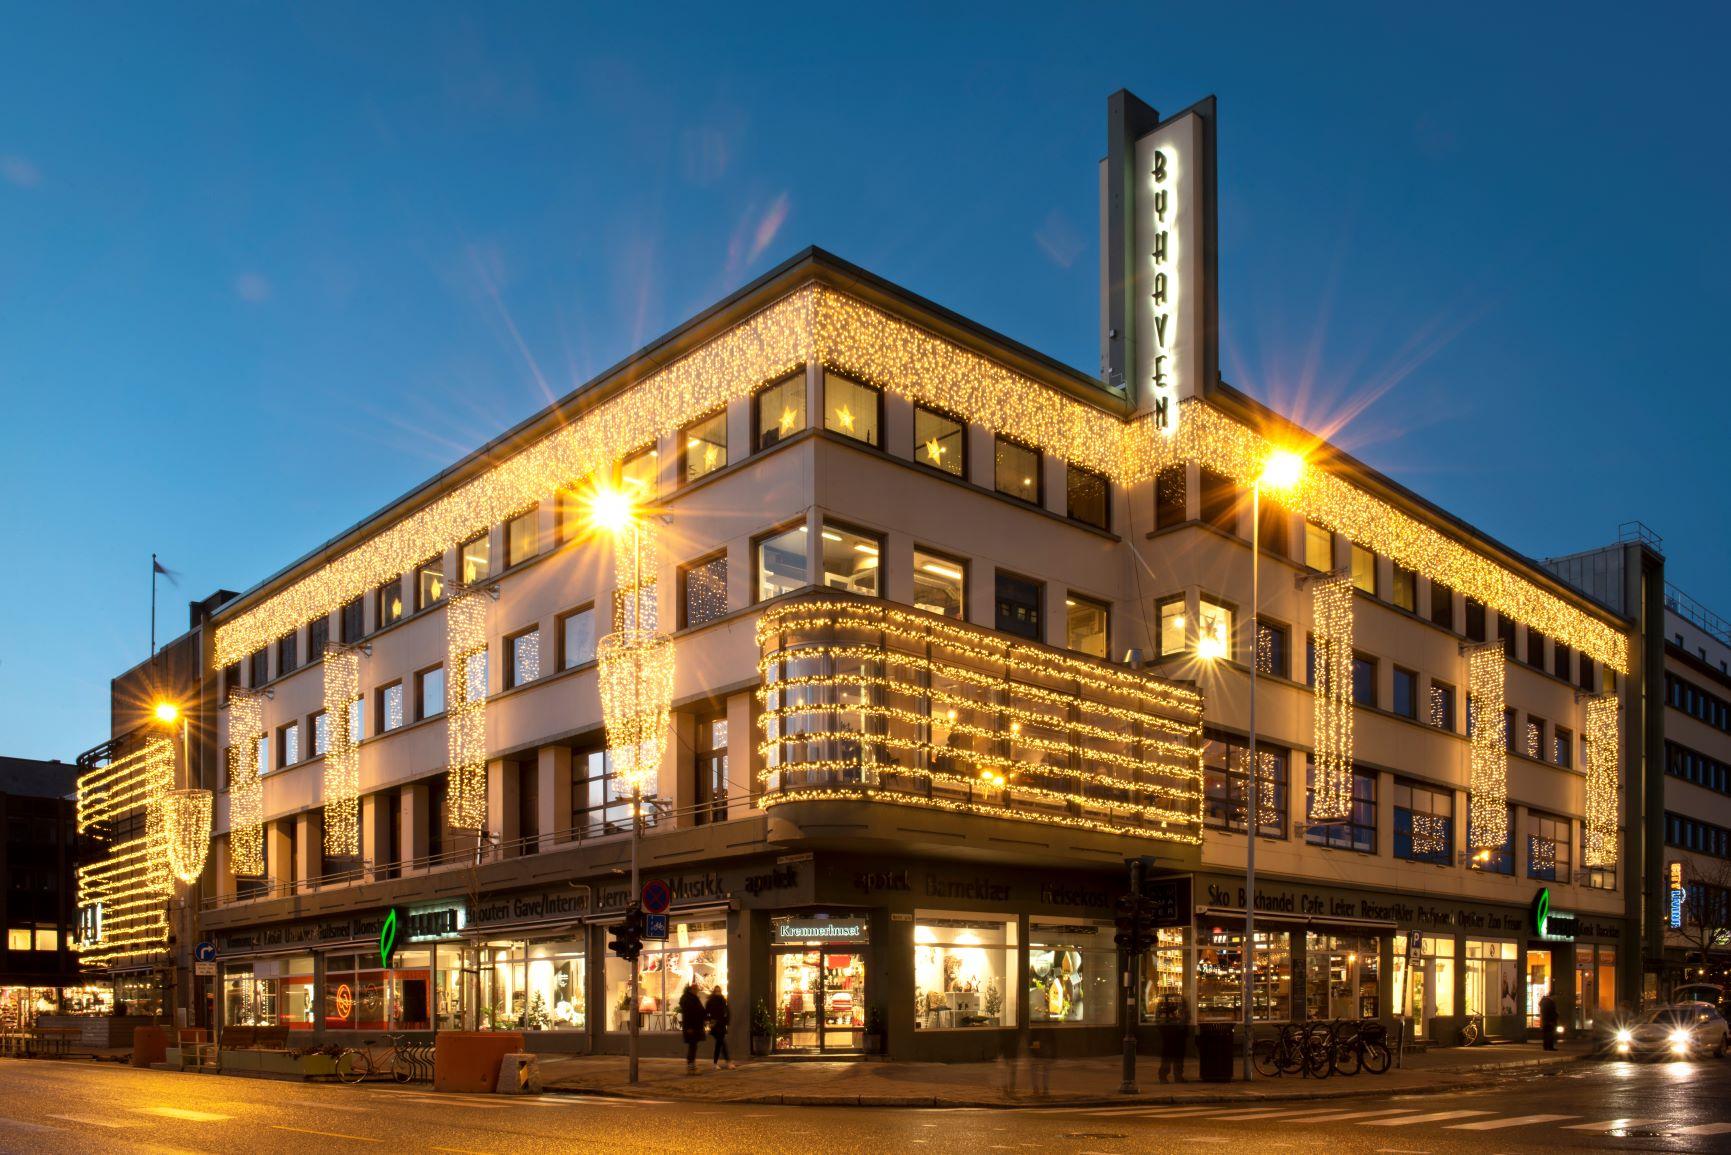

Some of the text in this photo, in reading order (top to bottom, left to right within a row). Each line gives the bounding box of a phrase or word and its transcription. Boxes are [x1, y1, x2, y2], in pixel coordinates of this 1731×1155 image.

[1152, 150, 1168, 430] BYHAVEN
[669, 872, 723, 899] Musikk
[1208, 884, 1230, 906] Sko
[1238, 888, 1294, 912] Bkhandel
[1301, 894, 1324, 914] Cafe
[1413, 932, 1420, 947] P
